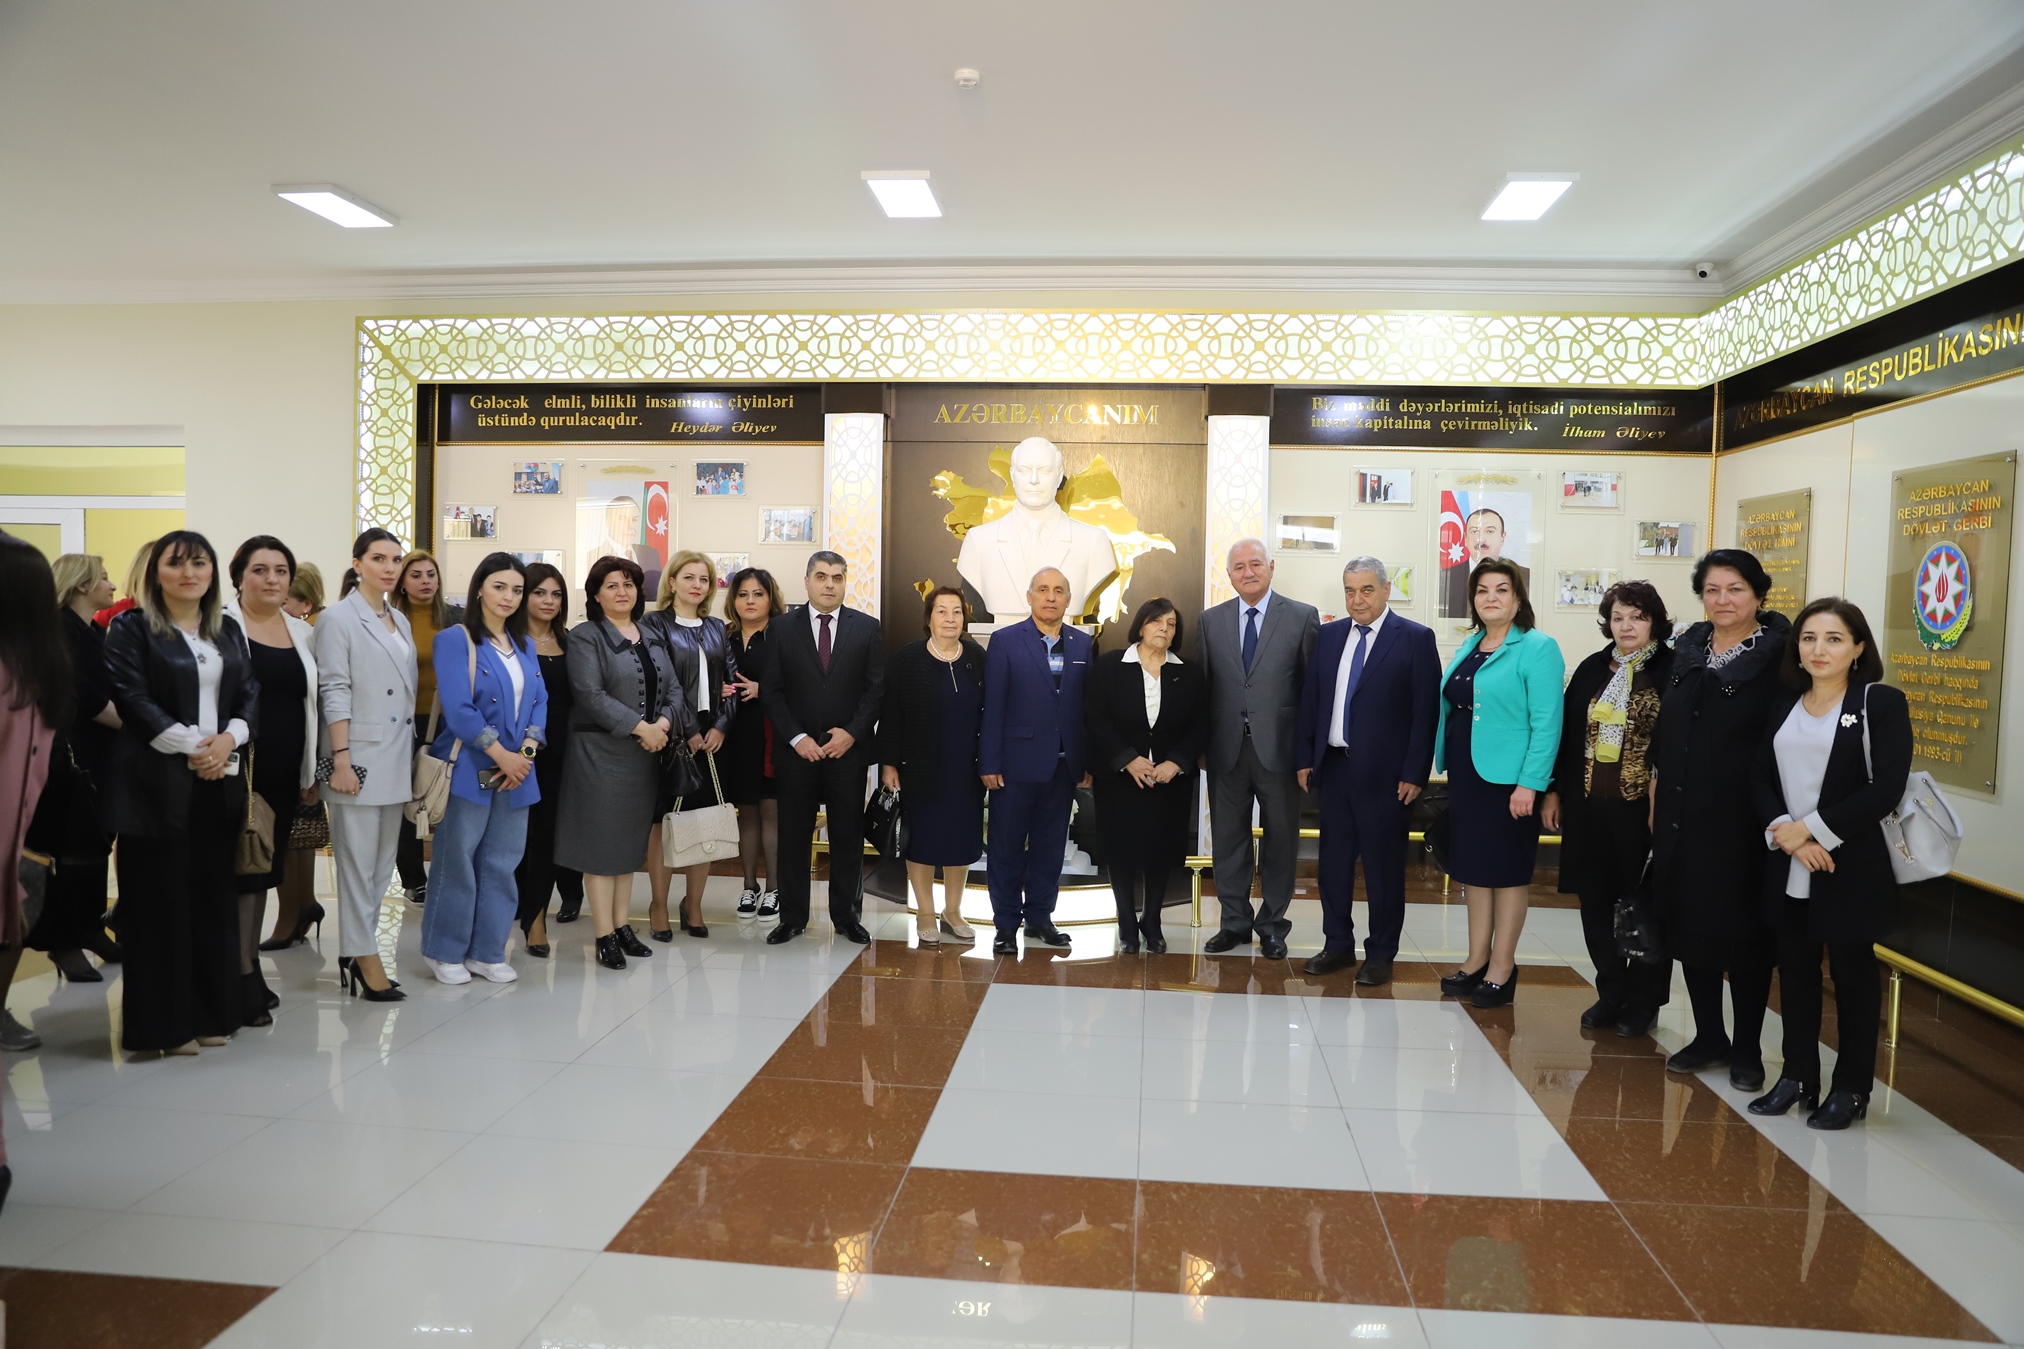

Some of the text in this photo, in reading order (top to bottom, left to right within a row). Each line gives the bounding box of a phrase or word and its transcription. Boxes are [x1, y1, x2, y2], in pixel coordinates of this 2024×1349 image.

[469, 395, 794, 411] Gələcək elmli, bilikli insanların çiyinləri
[1311, 397, 1336, 411] Biz
[1399, 399, 1504, 416] dəyərlərimizi,
[1508, 401, 1564, 418] iqtisadi
[1569, 402, 1676, 420] potensialımızı
[477, 413, 642, 430] üstündə qurulacaqdır.
[934, 403, 1160, 425] AZƏRBAYCANIM
[670, 421, 777, 435] Heydər Əliyev
[1311, 415, 1538, 434] insan kapitalına çevirməliyik.
[1562, 424, 1666, 441] İlham Əliyev
[1910, 478, 1990, 502] AZƏRBAYCAN
[1748, 508, 1795, 523] AZƏRBAYCAN
[1898, 495, 2001, 519] RESPUBLİKASININ
[1904, 513, 1991, 535] DÖVLƏT GERBİ
[1932, 653, 1990, 670] Respublikasının
